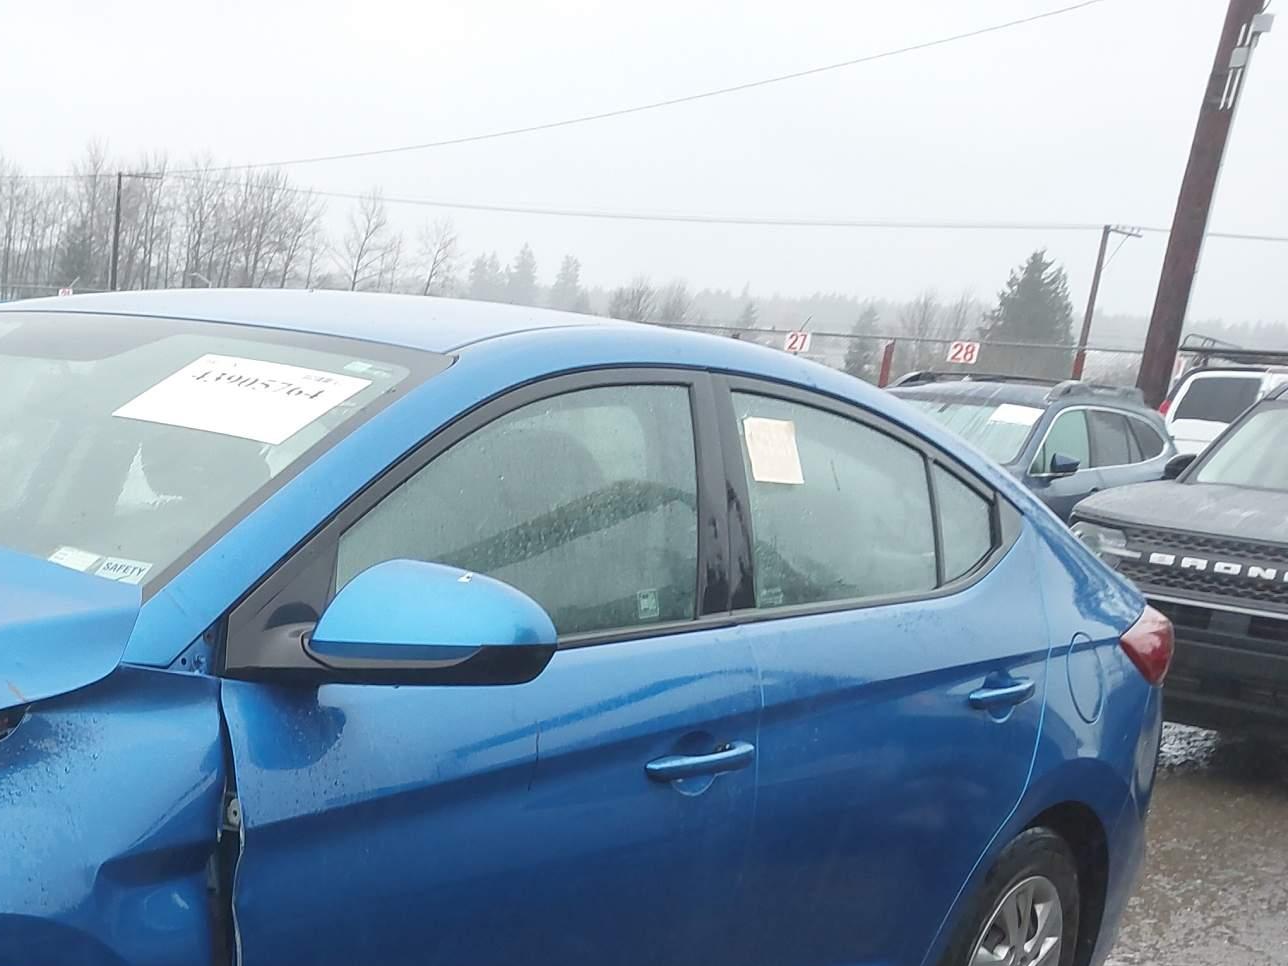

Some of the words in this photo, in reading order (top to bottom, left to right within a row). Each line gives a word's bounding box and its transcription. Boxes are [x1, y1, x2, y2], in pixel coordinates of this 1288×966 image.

[787, 333, 808, 350] 27
[950, 343, 978, 362] 28
[103, 562, 147, 577] SAFETY
[1149, 552, 1288, 582] BRON
